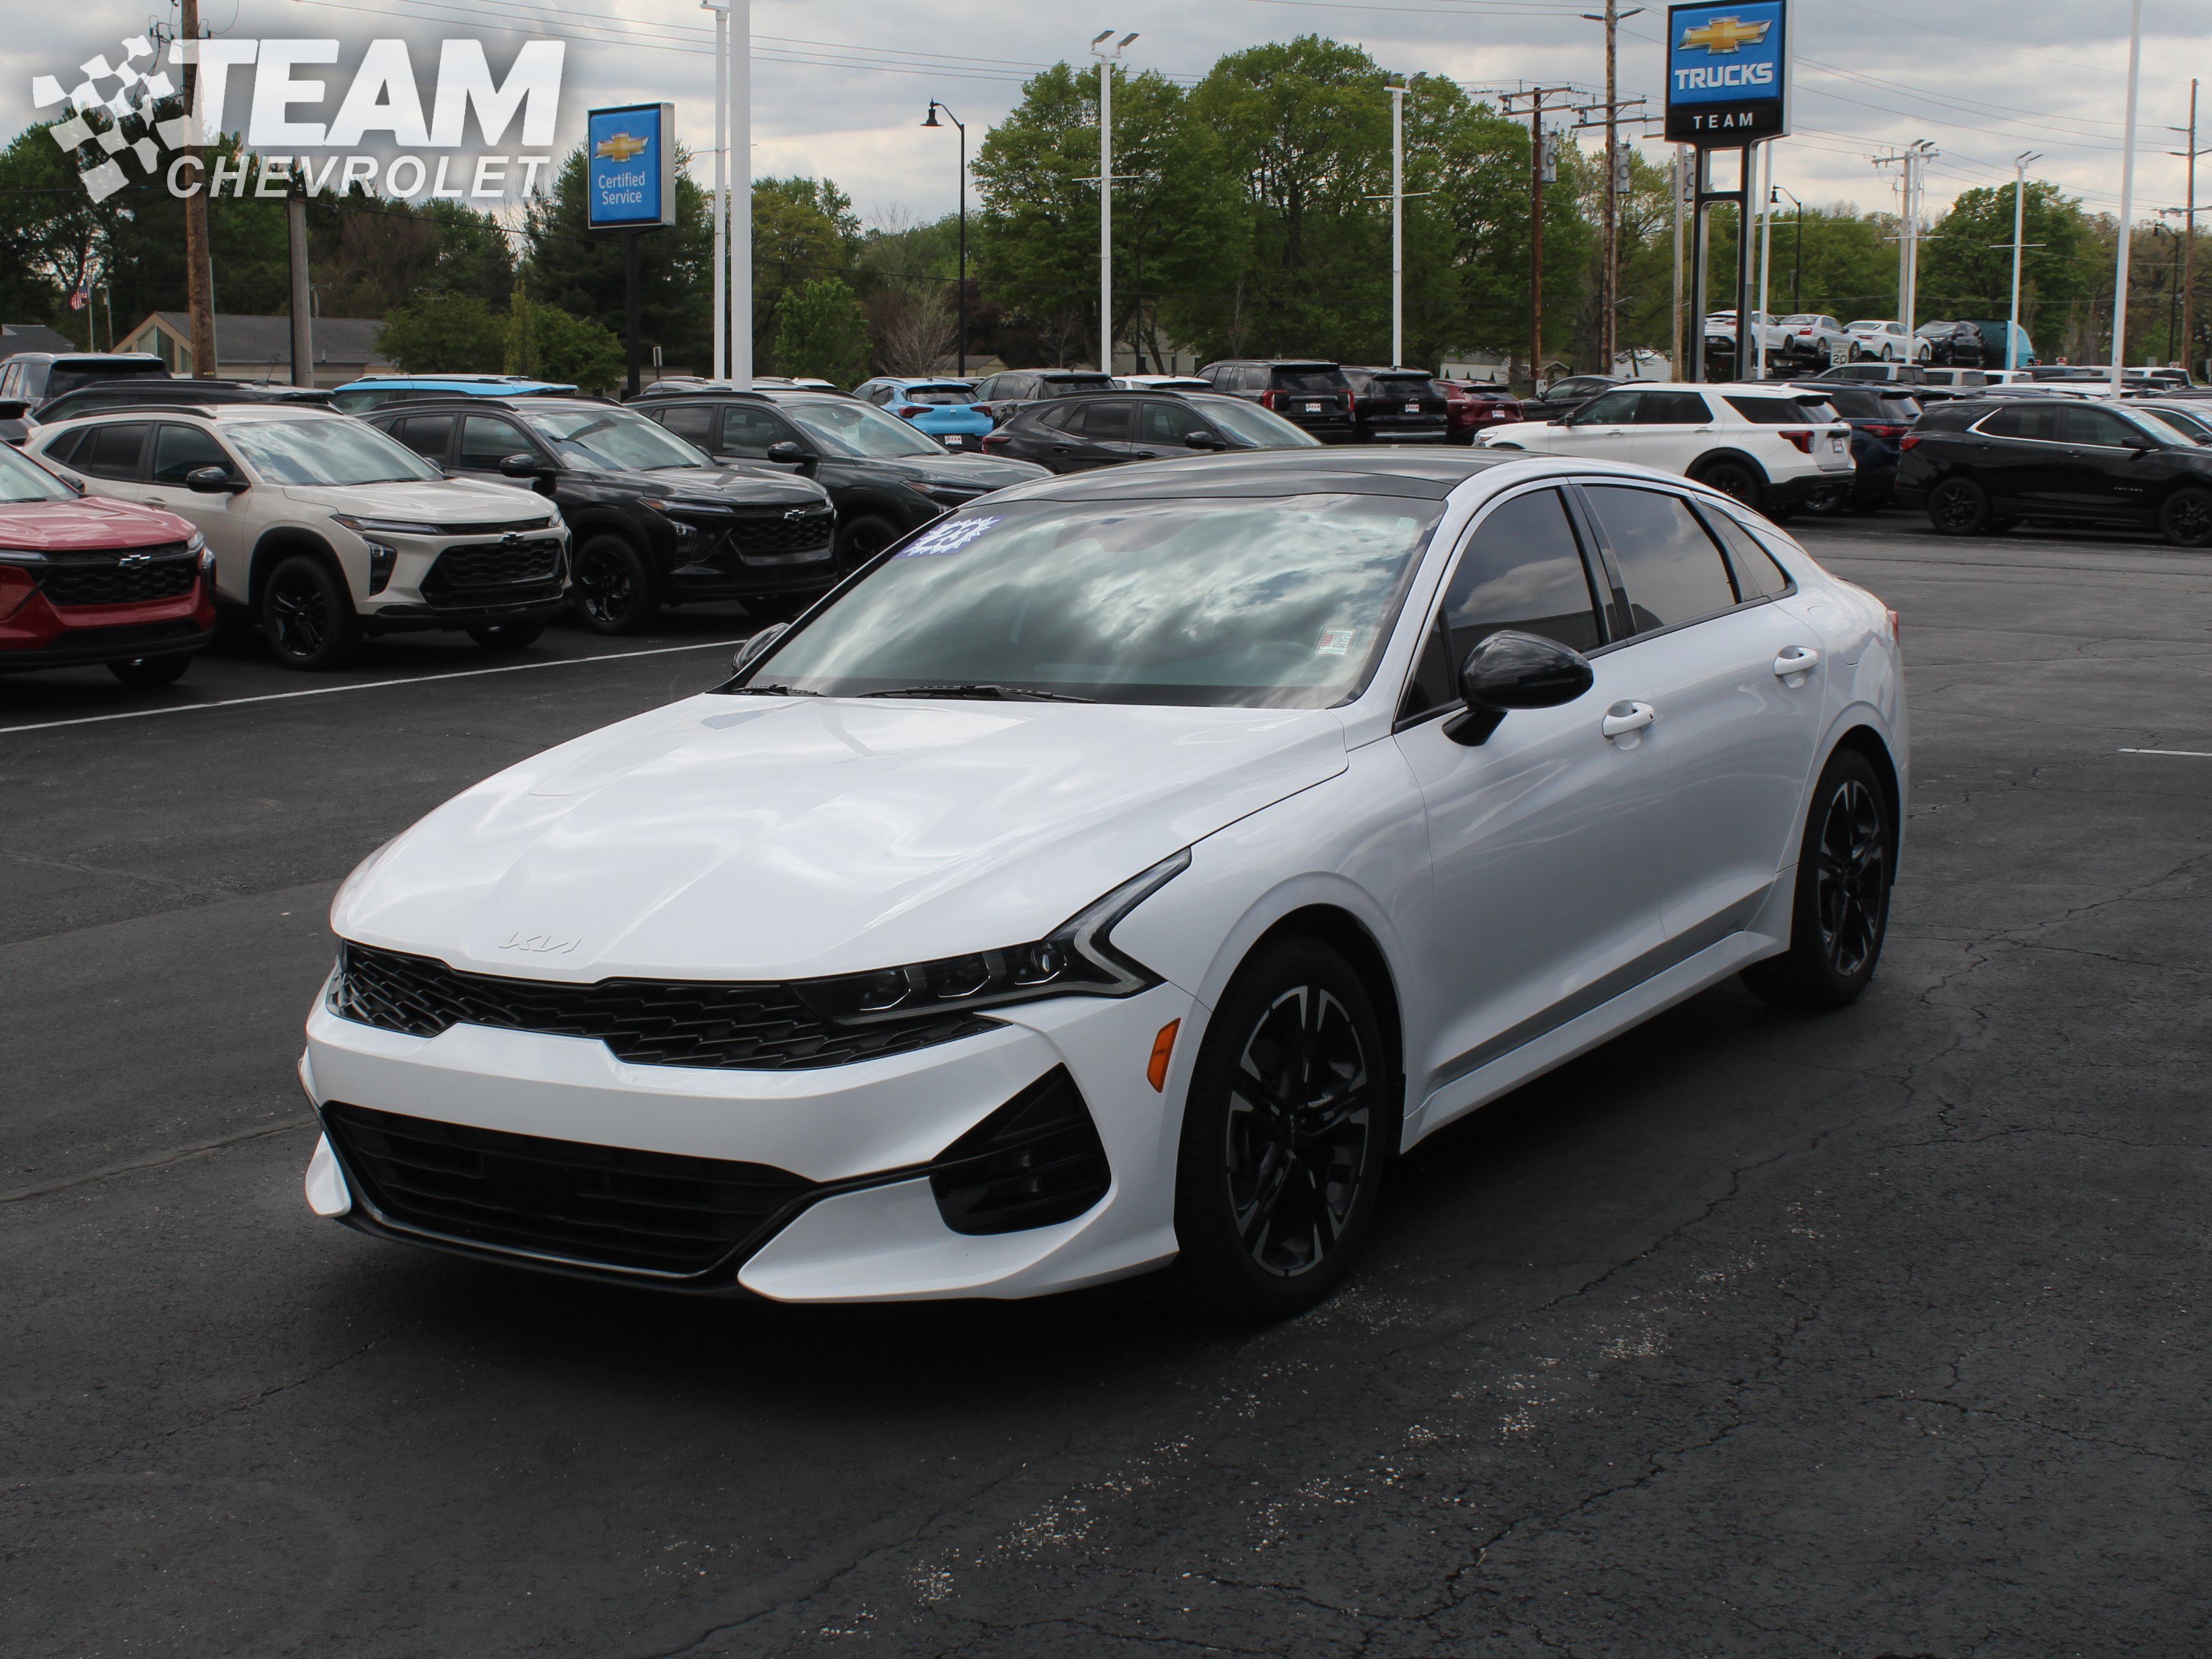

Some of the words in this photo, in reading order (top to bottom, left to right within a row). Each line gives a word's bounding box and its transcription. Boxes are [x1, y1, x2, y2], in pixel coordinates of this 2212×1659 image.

[1674, 62, 1774, 91] TRUCKS
[1693, 112, 1754, 130] TEAM
[598, 171, 646, 189] Certified
[602, 189, 642, 205] Service
[1833, 354, 1847, 365] 20
[920, 523, 981, 547] 23
